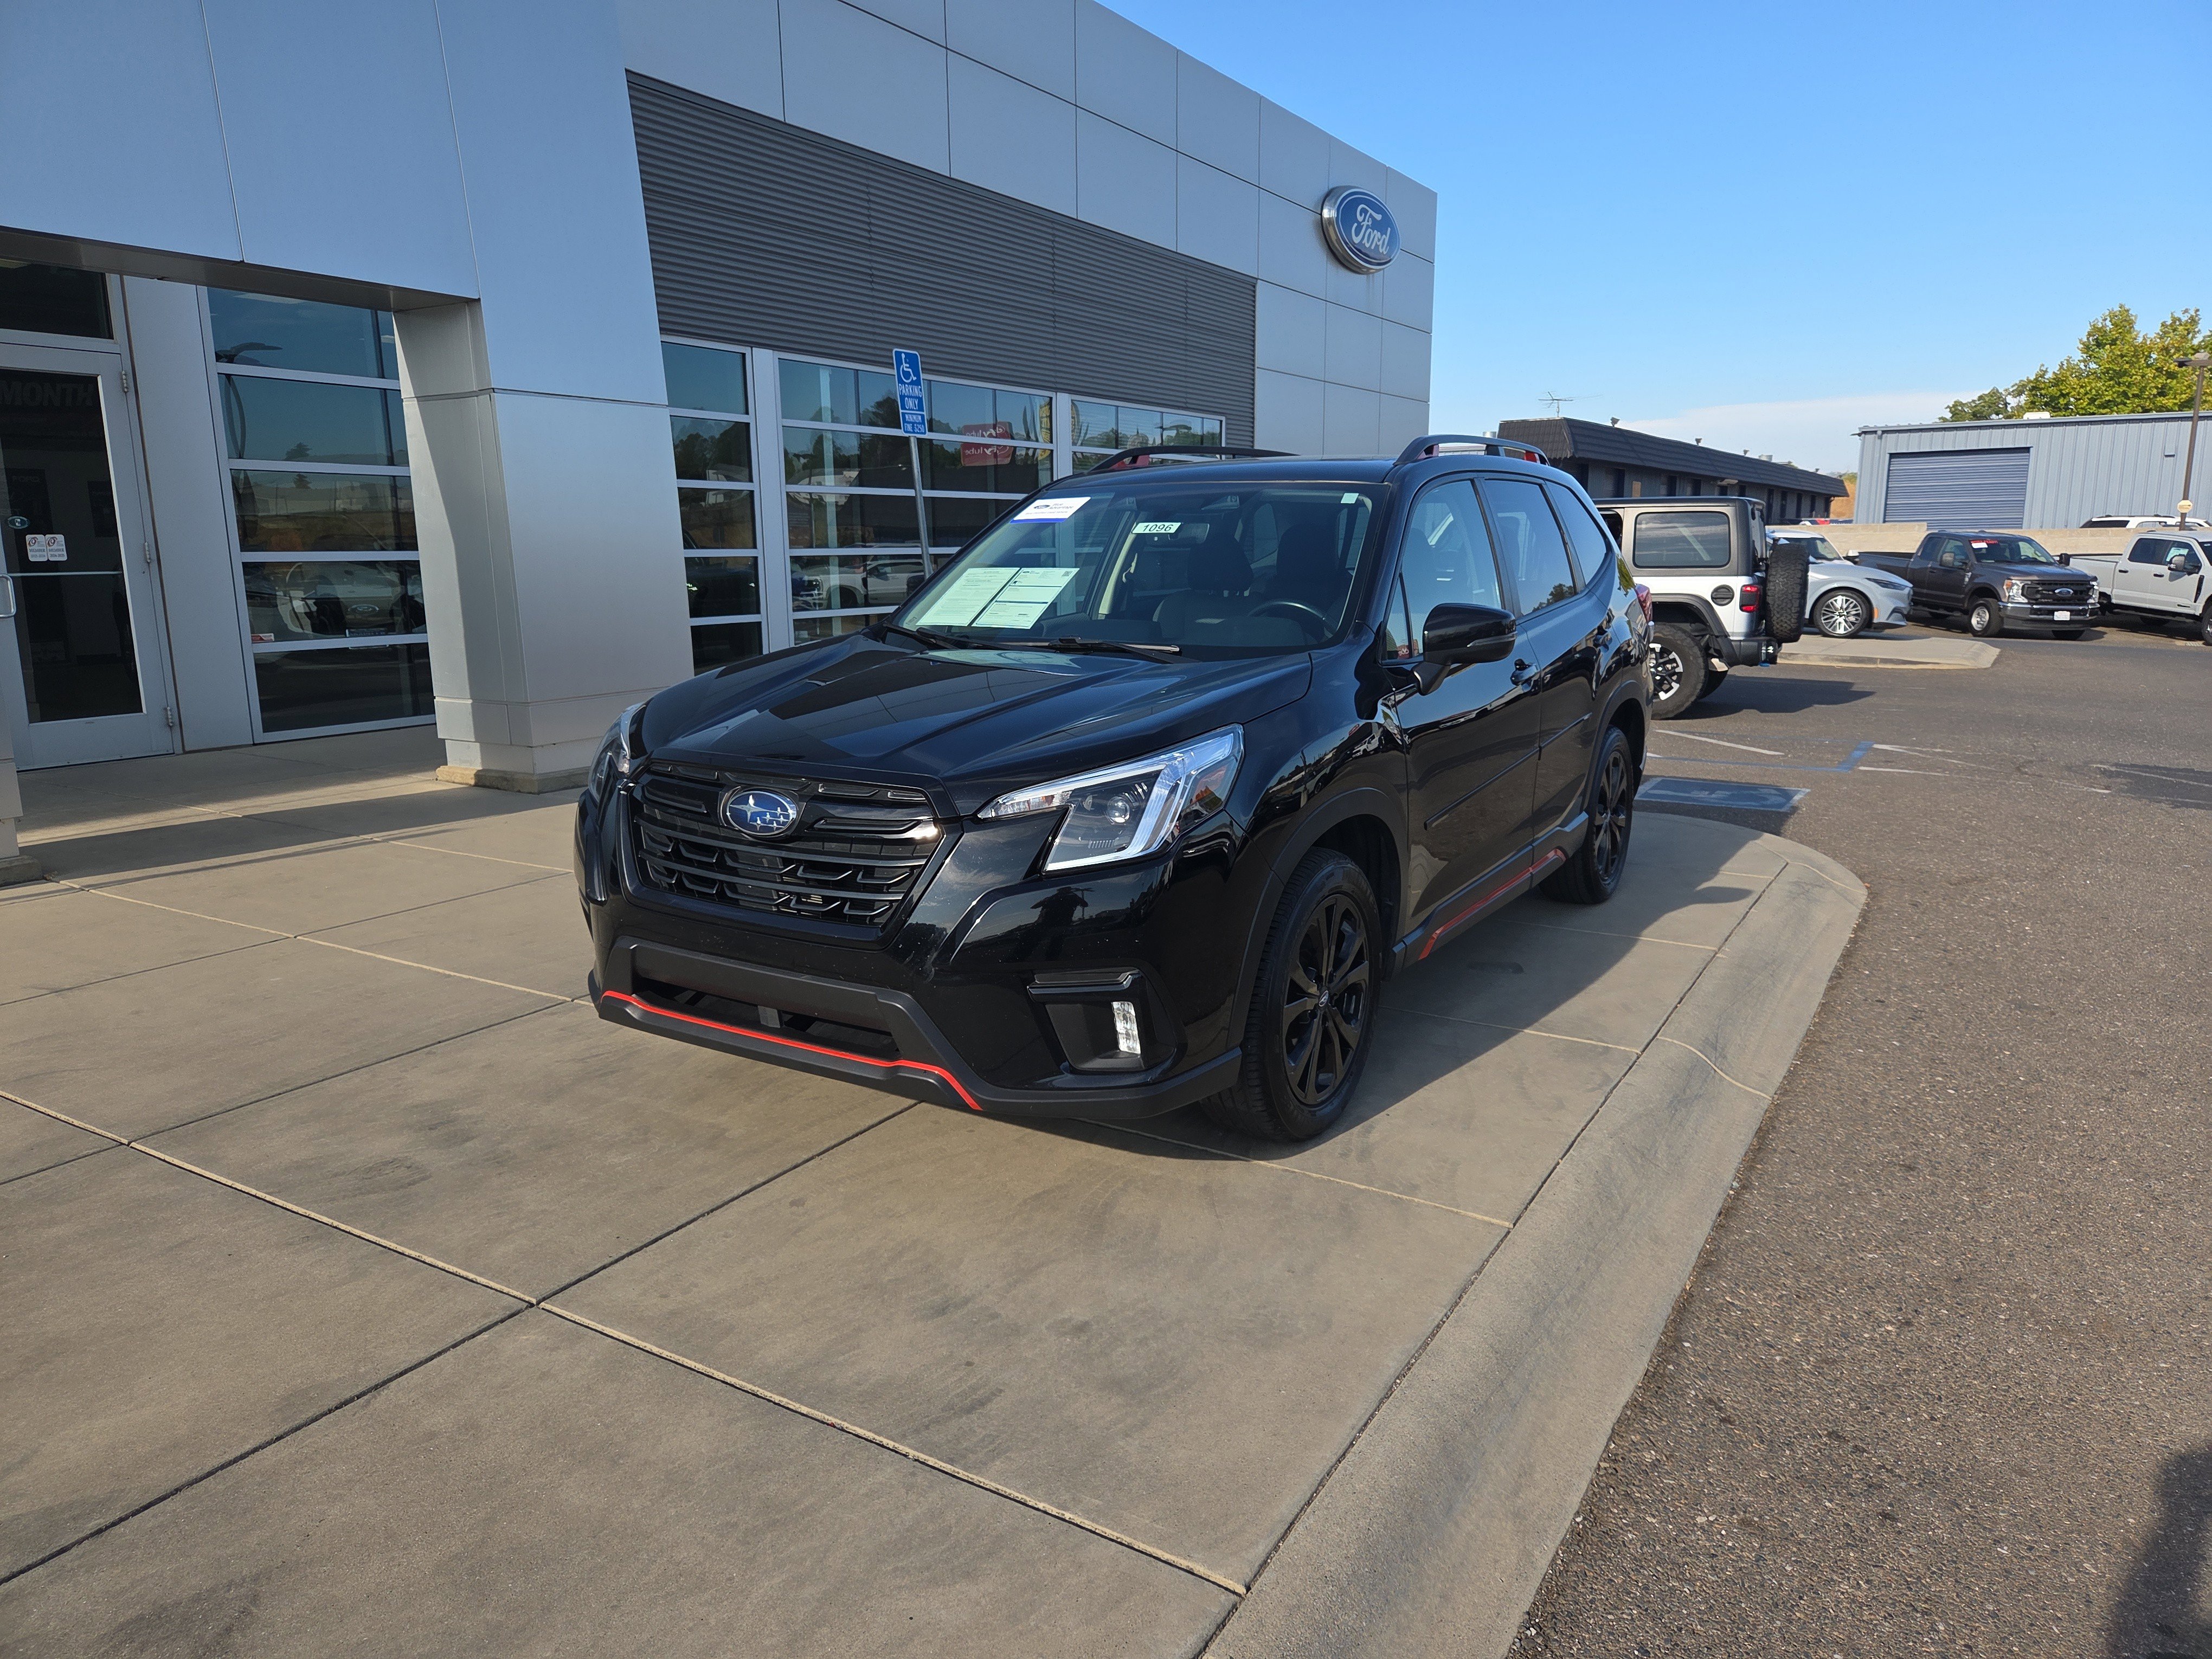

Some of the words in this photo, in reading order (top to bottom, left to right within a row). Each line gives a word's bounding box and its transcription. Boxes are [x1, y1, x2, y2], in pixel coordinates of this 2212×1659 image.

[1351, 204, 1391, 255] Ford
[898, 383, 922, 398] PARKING
[904, 397, 918, 410] ONLY
[1143, 524, 1174, 532] 1096
